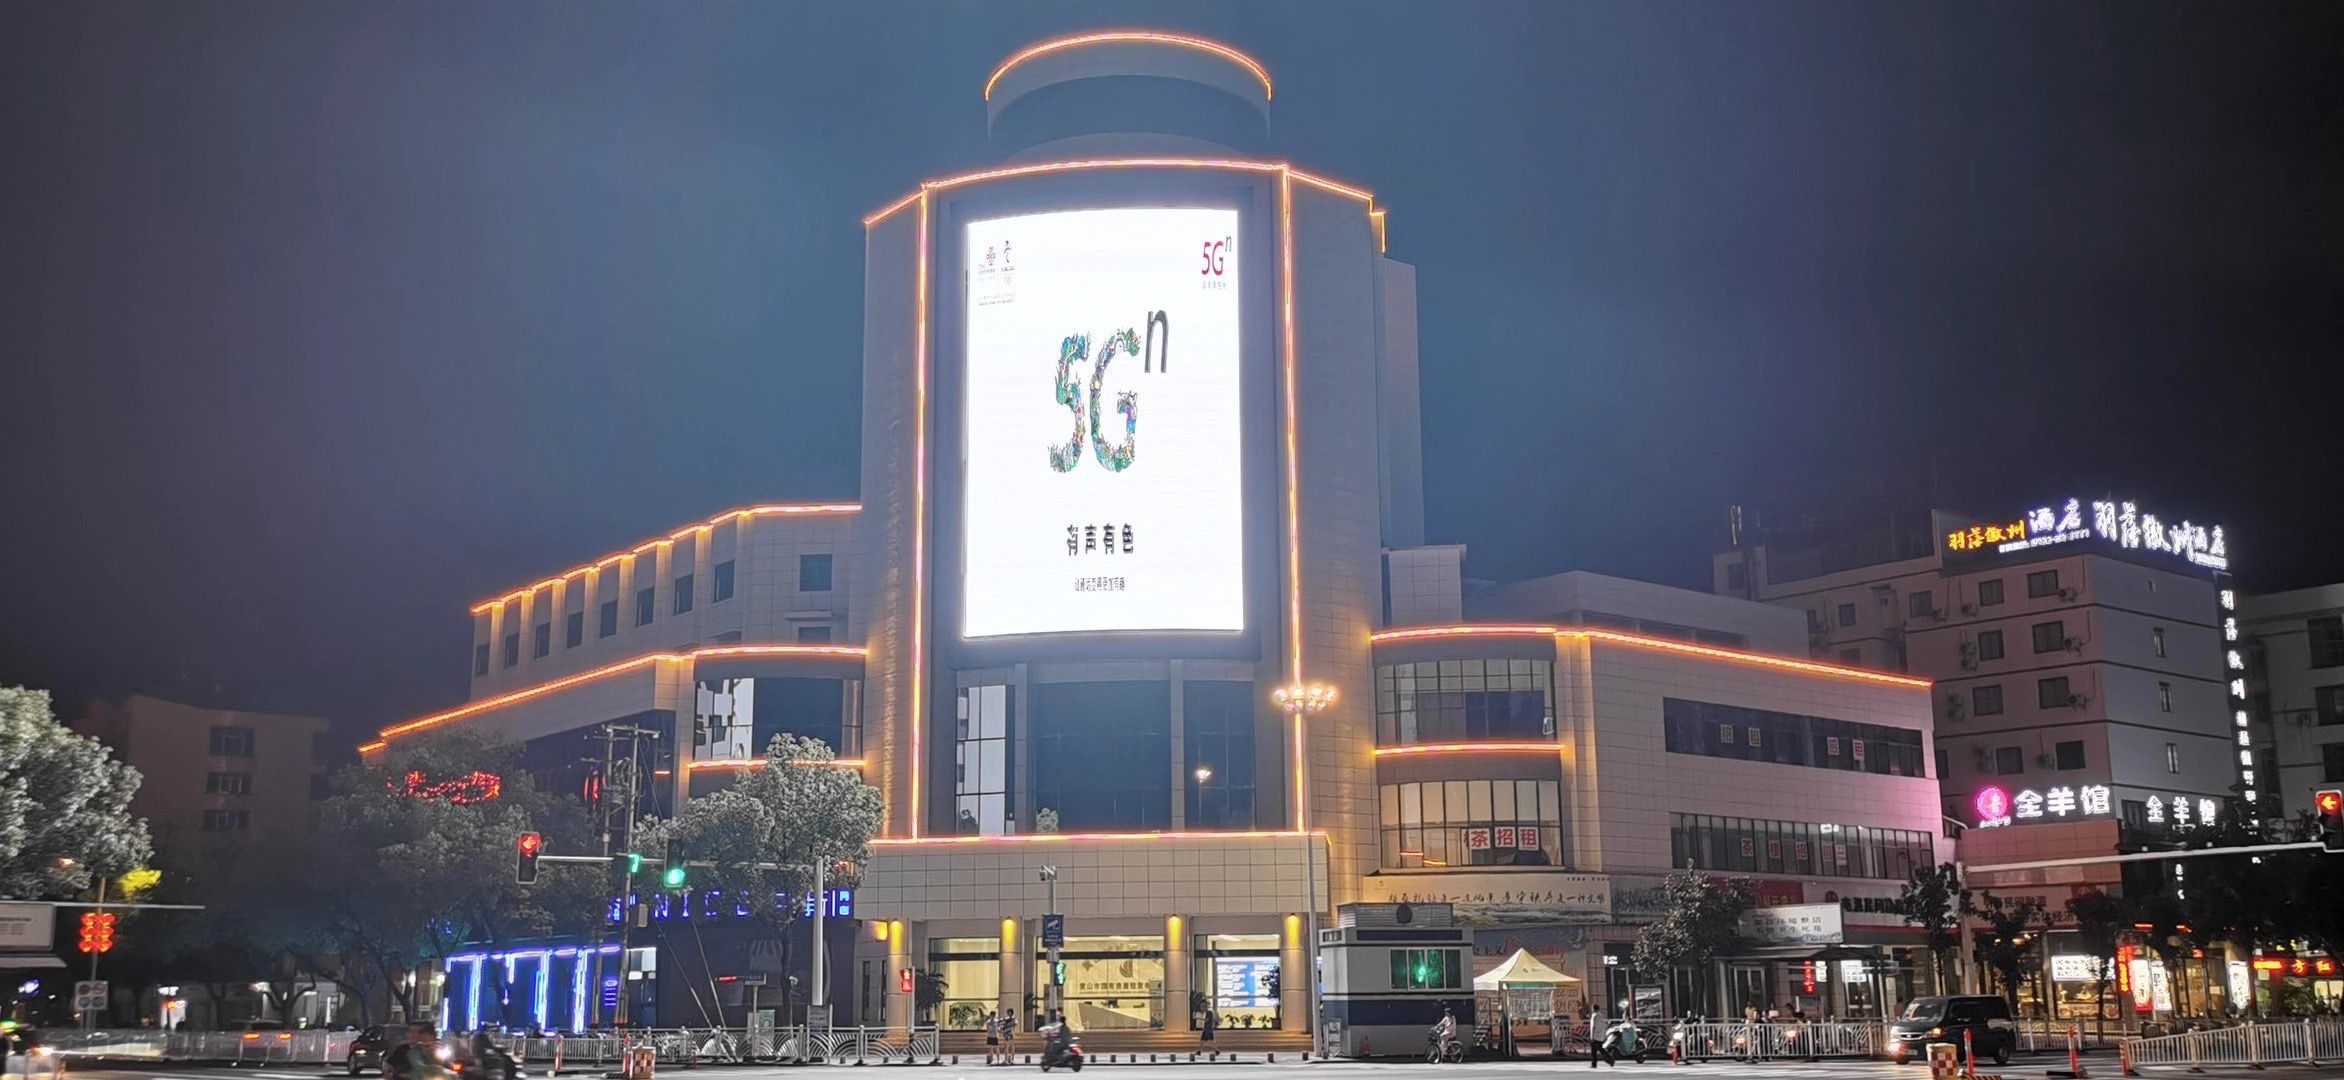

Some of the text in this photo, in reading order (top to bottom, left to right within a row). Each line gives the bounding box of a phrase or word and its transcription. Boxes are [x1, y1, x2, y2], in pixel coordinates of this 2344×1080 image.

[1067, 523, 1134, 556] 有声有色
[2013, 784, 2111, 819] 全羊馆
[2145, 795, 2217, 826] 全羊馆
